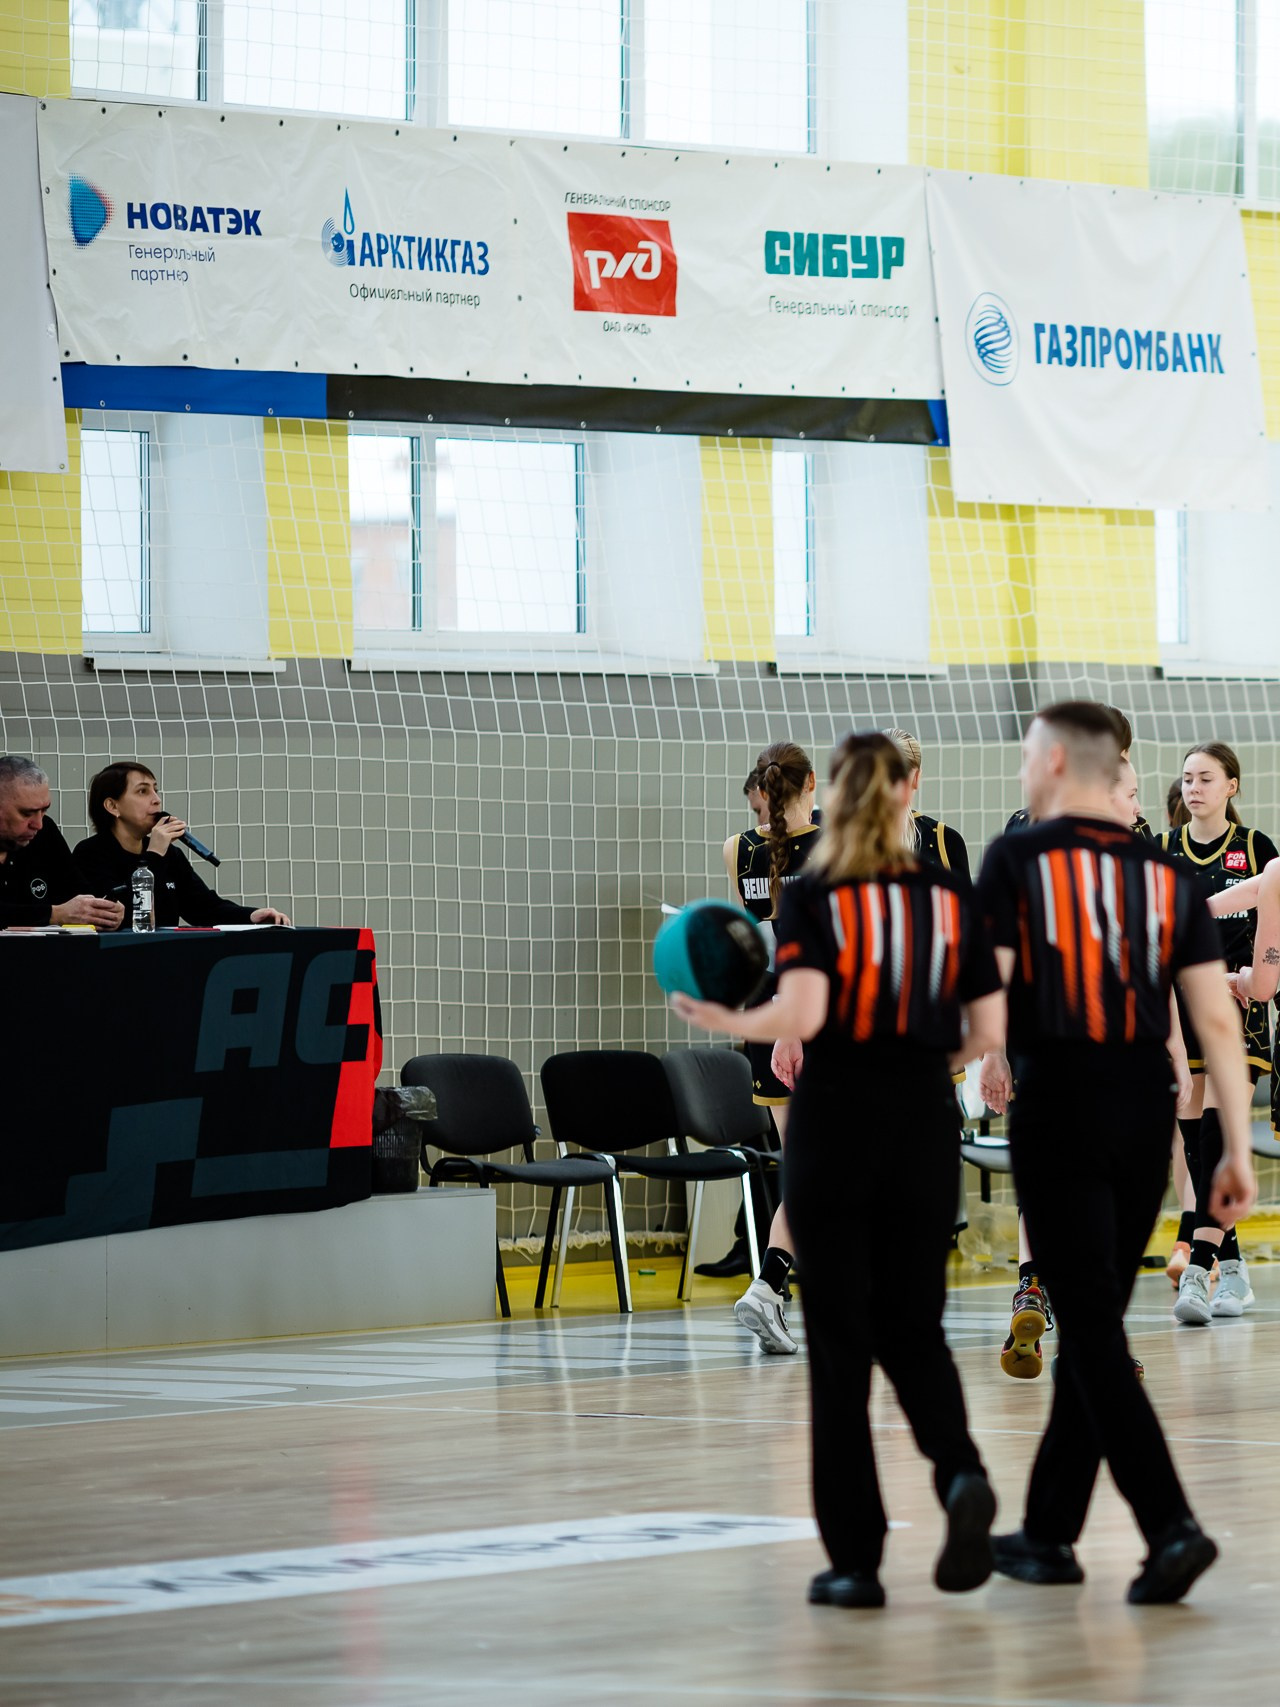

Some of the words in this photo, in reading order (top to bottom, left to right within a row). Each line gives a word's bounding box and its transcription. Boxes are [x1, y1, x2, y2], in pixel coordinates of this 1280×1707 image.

[628, 198, 671, 212] СПОНСОР
[127, 202, 263, 236] НОВАТЭК
[359, 232, 490, 276] АРКТИКГАЗ
[764, 230, 905, 279] СИБУР
[130, 268, 189, 285] партнер
[349, 283, 432, 303] Официальный
[435, 290, 481, 309] партнер
[768, 295, 858, 318] Генеральный
[860, 302, 910, 322] спонсор
[1033, 322, 1225, 374] ГАЗПРОМБАНК
[1226, 859, 1246, 867] BET
[1227, 852, 1246, 860] FON
